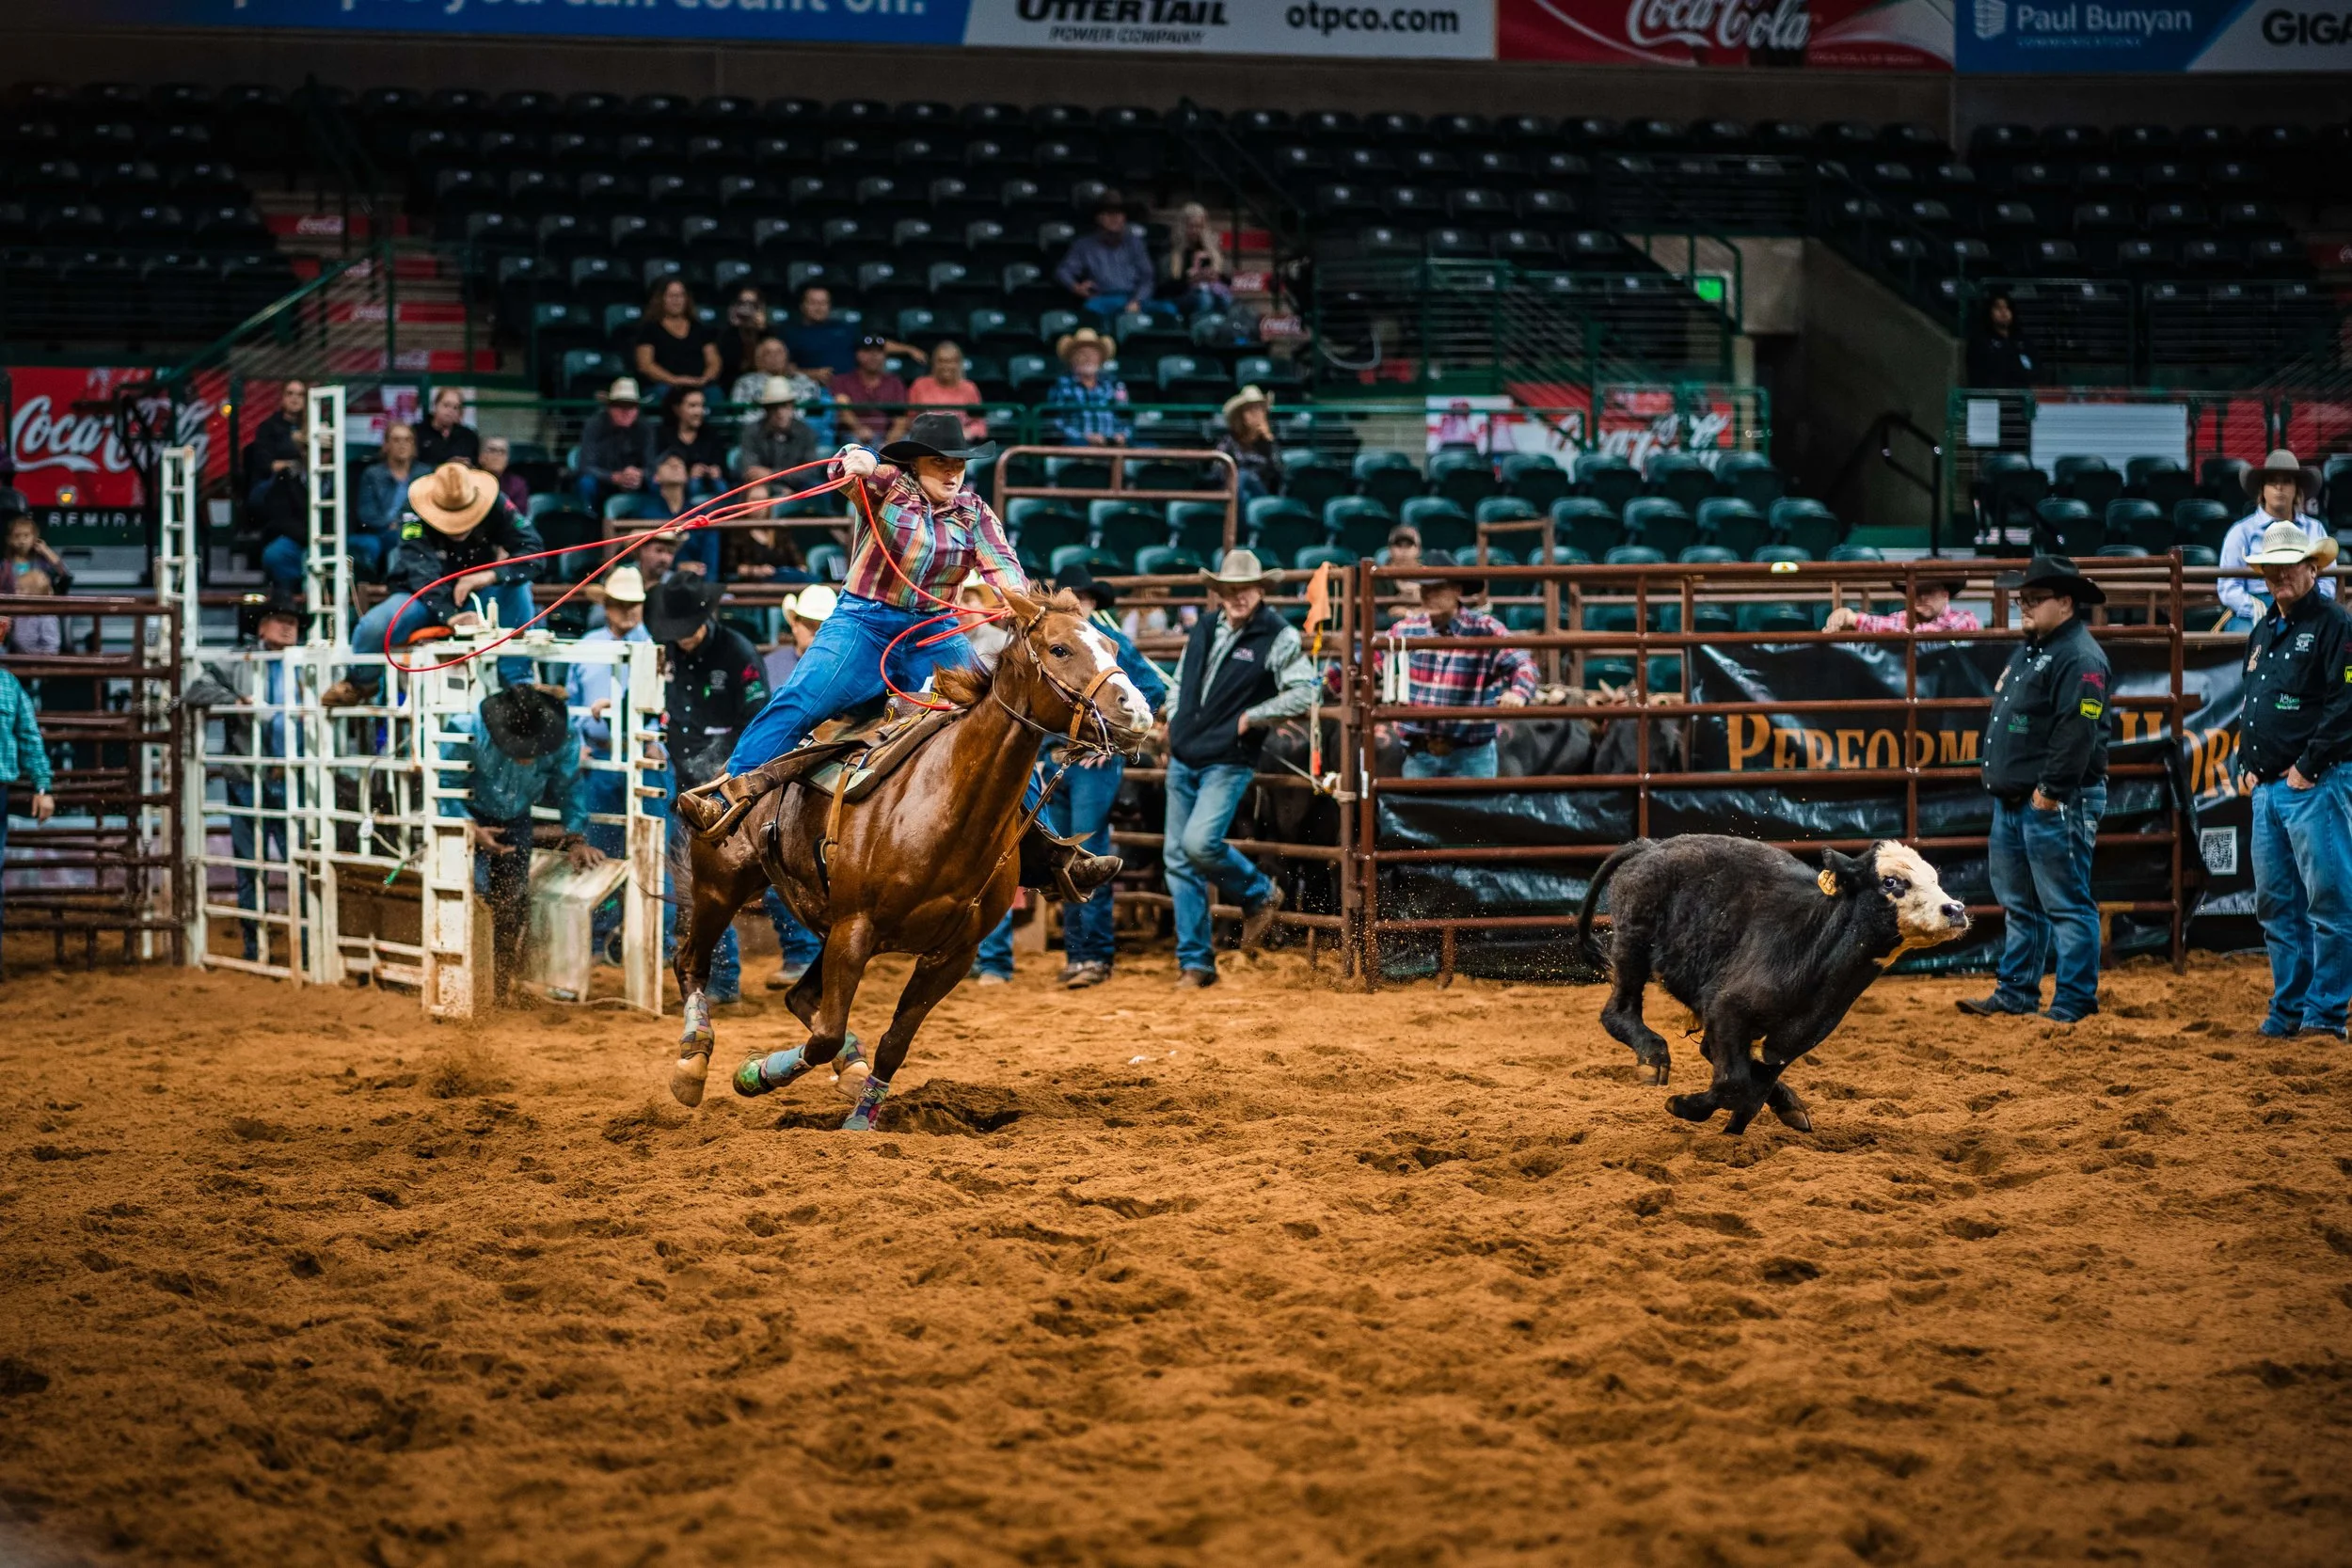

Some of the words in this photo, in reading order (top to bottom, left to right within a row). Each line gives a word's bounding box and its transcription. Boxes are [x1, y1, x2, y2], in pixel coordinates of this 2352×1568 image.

[1286, 0, 1459, 36] otpco.com
[2016, 2, 2077, 33] Paul
[2085, 6, 2193, 37] Bunyan
